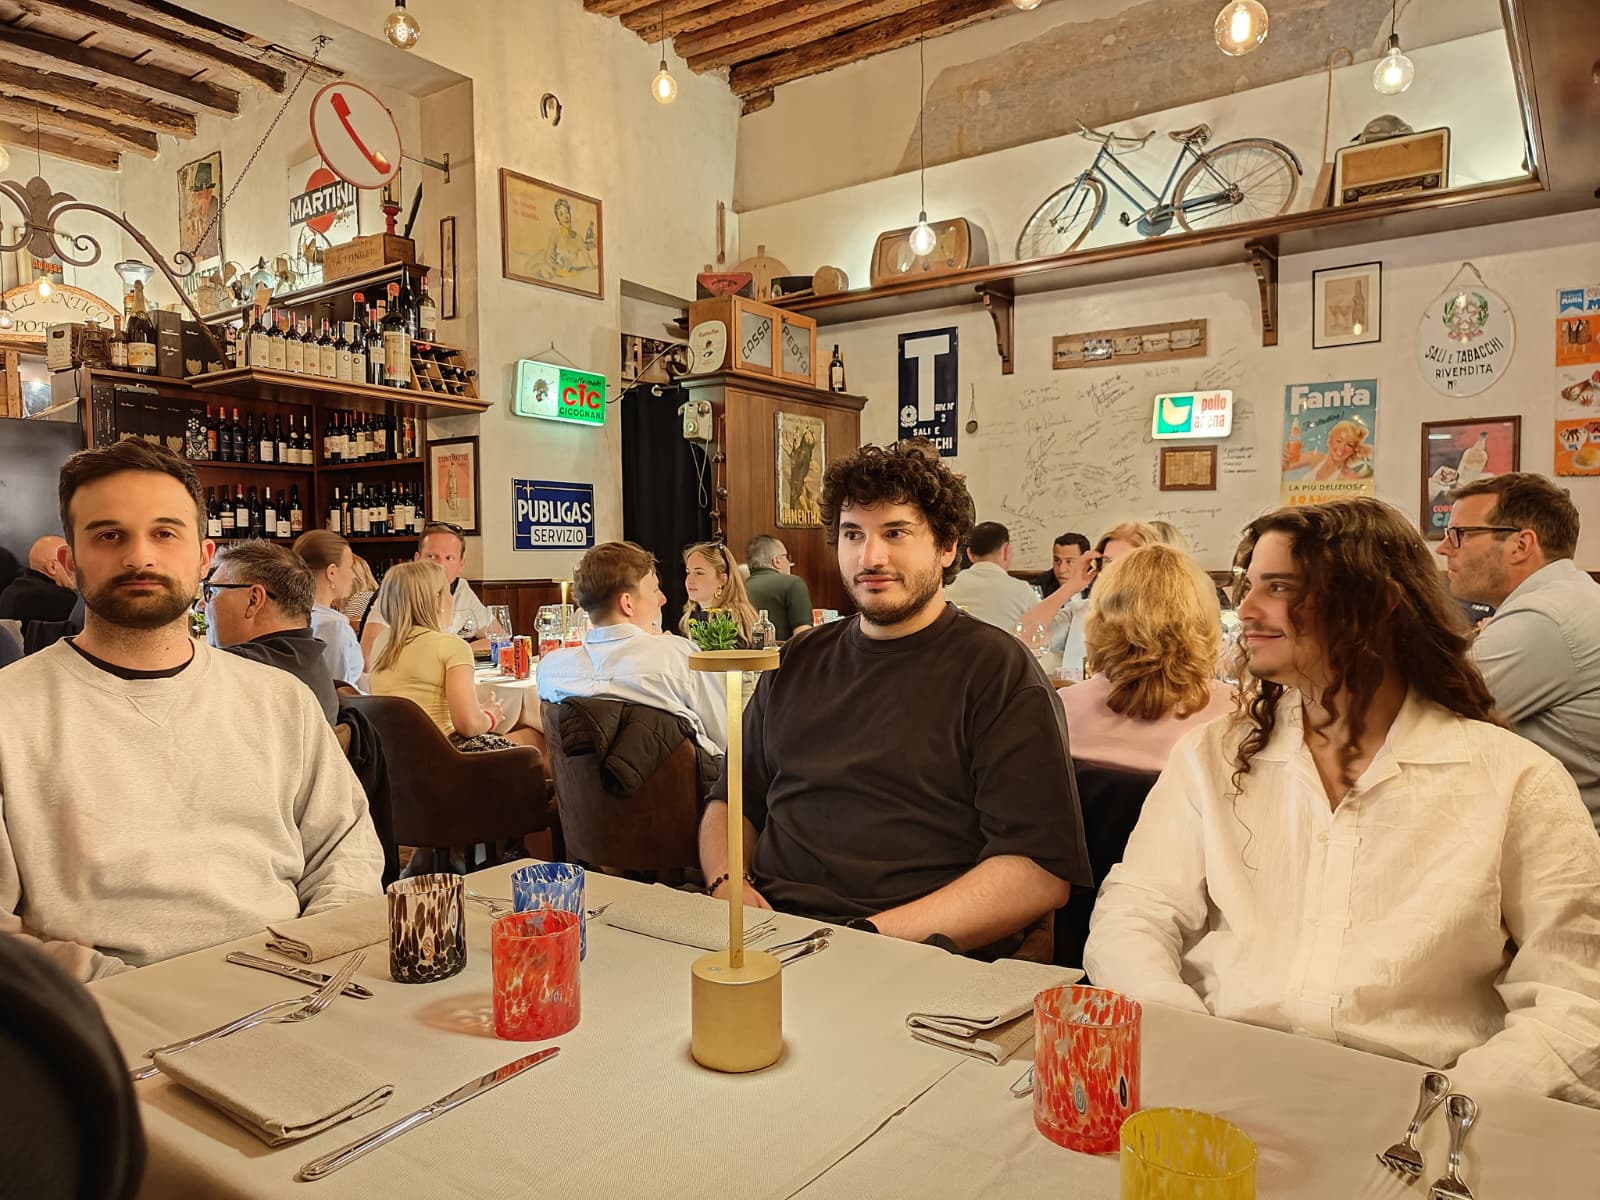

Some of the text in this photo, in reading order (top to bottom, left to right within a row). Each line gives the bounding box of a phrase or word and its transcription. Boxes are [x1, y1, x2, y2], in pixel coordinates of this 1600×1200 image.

[290, 182, 357, 224] MARTINI
[742, 319, 771, 360] CASSA
[1425, 345, 1447, 363] SALI
[1456, 336, 1504, 363] TABACCHI
[904, 334, 950, 421] T
[1435, 363, 1494, 379] RIVENDITA
[1201, 393, 1227, 414] pollo
[1290, 382, 1370, 416] Fanta
[940, 413, 946, 423] 2
[913, 426, 941, 436] SALI E
[1288, 484, 1299, 492] LA
[517, 499, 592, 523] PUBLIGAS
[534, 528, 584, 543] SERVIZIO
